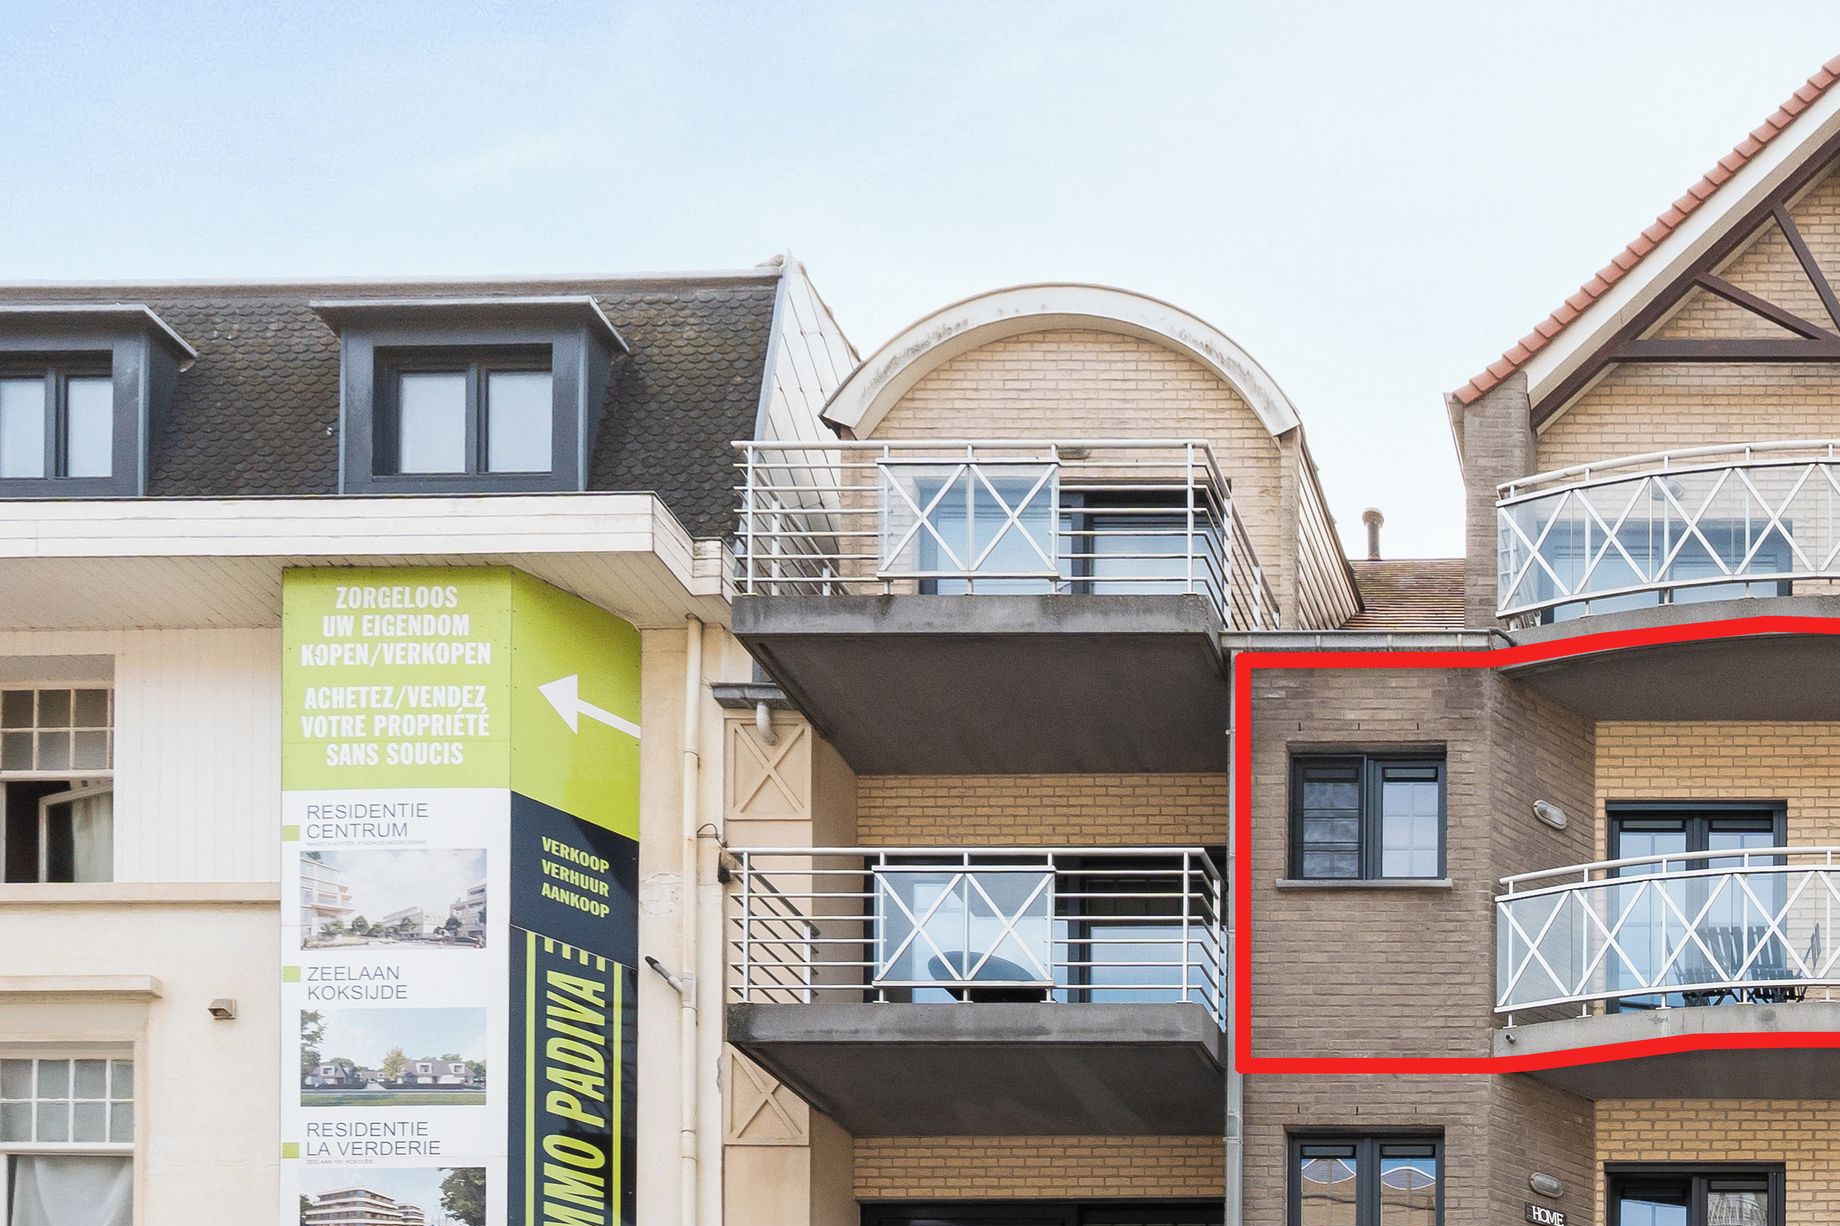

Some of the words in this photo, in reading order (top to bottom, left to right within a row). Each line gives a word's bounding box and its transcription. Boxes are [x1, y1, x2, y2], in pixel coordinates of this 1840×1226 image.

[335, 585, 458, 609] ZORGELOOS
[322, 614, 355, 637] UW
[361, 613, 470, 637] EIGENDOM
[301, 642, 491, 668] KOPEN/VERKOPEN
[304, 685, 487, 710] ACHETEZ/VENDEZ
[301, 714, 367, 738] VOTRE
[373, 707, 490, 737] PROPRIÉTÉ
[325, 742, 380, 766] SANS
[386, 742, 464, 766] SOUCIS
[307, 803, 429, 820] RESIDENTIE
[306, 822, 408, 839] CENTRUM
[541, 836, 610, 873] VERKOOP
[541, 859, 609, 897] VERHUUR
[541, 882, 610, 918] AANKOOP
[307, 966, 400, 981] ZEELAAN
[308, 985, 408, 1000] KOKSIJDE
[546, 970, 605, 1128] PADIVA
[307, 1121, 428, 1137] RESIDENTIE
[306, 1141, 331, 1156] LA
[337, 1140, 441, 1156] VERDERIE
